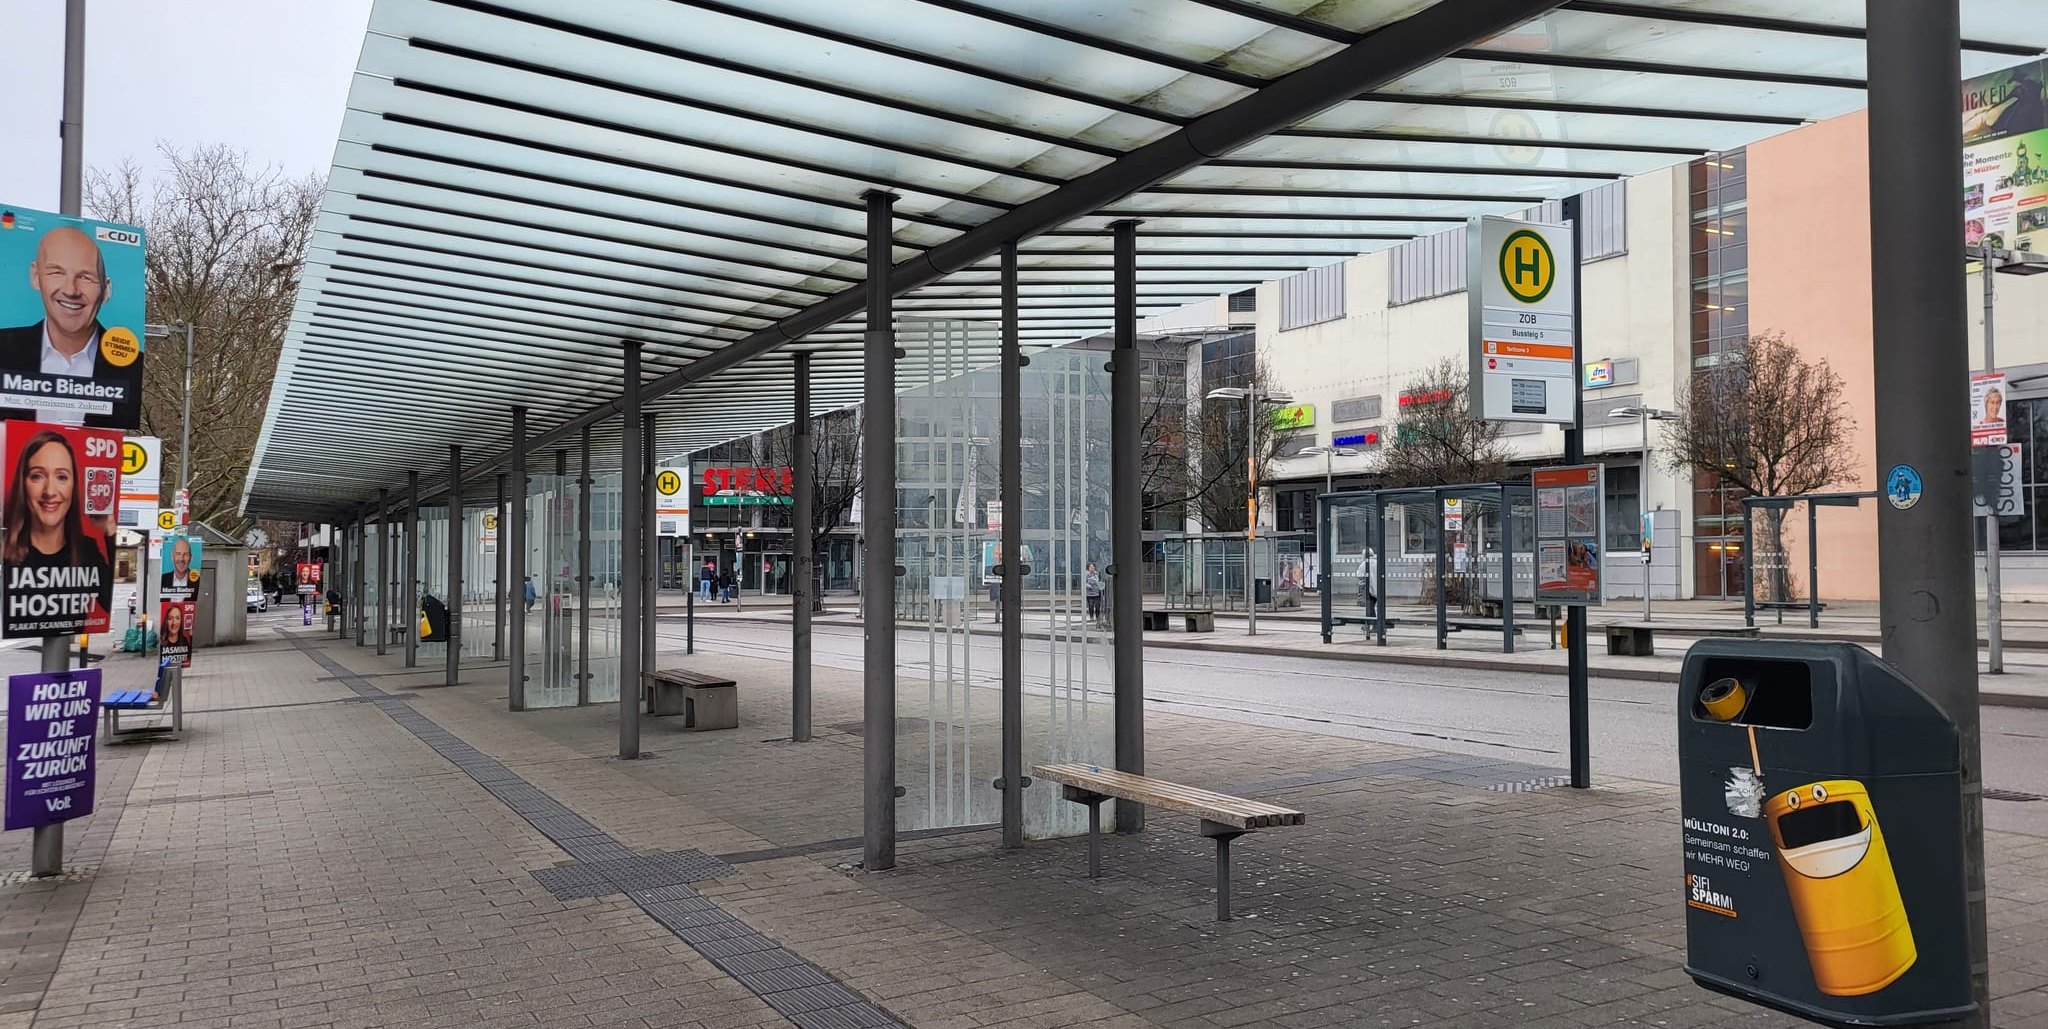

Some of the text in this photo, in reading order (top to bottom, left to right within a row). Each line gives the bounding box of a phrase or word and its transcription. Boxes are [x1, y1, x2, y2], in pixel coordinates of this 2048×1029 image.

[108, 230, 139, 244] CDU
[1519, 313, 1537, 324] ZOB
[111, 335, 131, 345] BEIDE
[1512, 328, 1538, 340] Bussteig
[104, 341, 136, 353] STIMMEN
[111, 349, 128, 358] CDU
[1593, 366, 1606, 376] dm
[3, 373, 124, 399] Marc Biadacz
[85, 436, 118, 459] SPD
[90, 484, 111, 497] SPD
[8, 566, 100, 589] JASMINA
[9, 592, 99, 617] HOSTERT
[8, 622, 39, 631] PLAKAT
[32, 681, 87, 701] HOLEN
[25, 699, 92, 721] WIR UNS
[48, 720, 75, 738] DIE
[16, 735, 91, 761] ZUKUNFT
[22, 754, 88, 780] ZURÜCK
[45, 796, 72, 812] Volt
[1684, 818, 1749, 840] MÜLLTONI 2.0:
[1684, 834, 1770, 861] Gemeinsam schaffen
[1685, 850, 1697, 859] wir
[1697, 852, 1724, 866] MEHR
